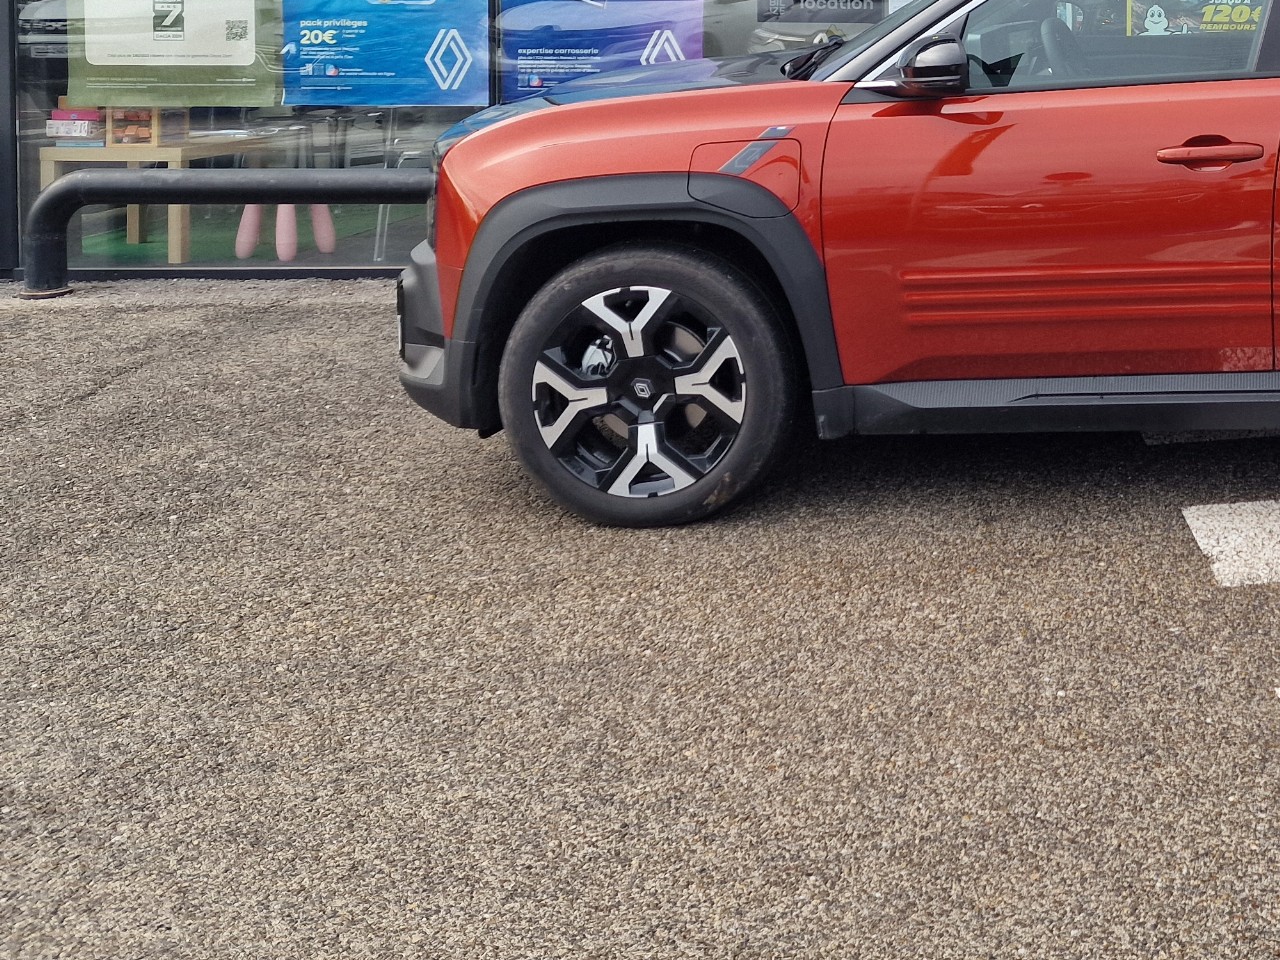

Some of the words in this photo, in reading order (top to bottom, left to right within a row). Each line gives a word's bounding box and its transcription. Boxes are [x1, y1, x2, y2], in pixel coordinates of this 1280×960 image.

[155, 4, 182, 25] 7
[300, 19, 322, 27] pack
[323, 19, 368, 28] privilèges
[1200, 23, 1257, 31] REMBOURS
